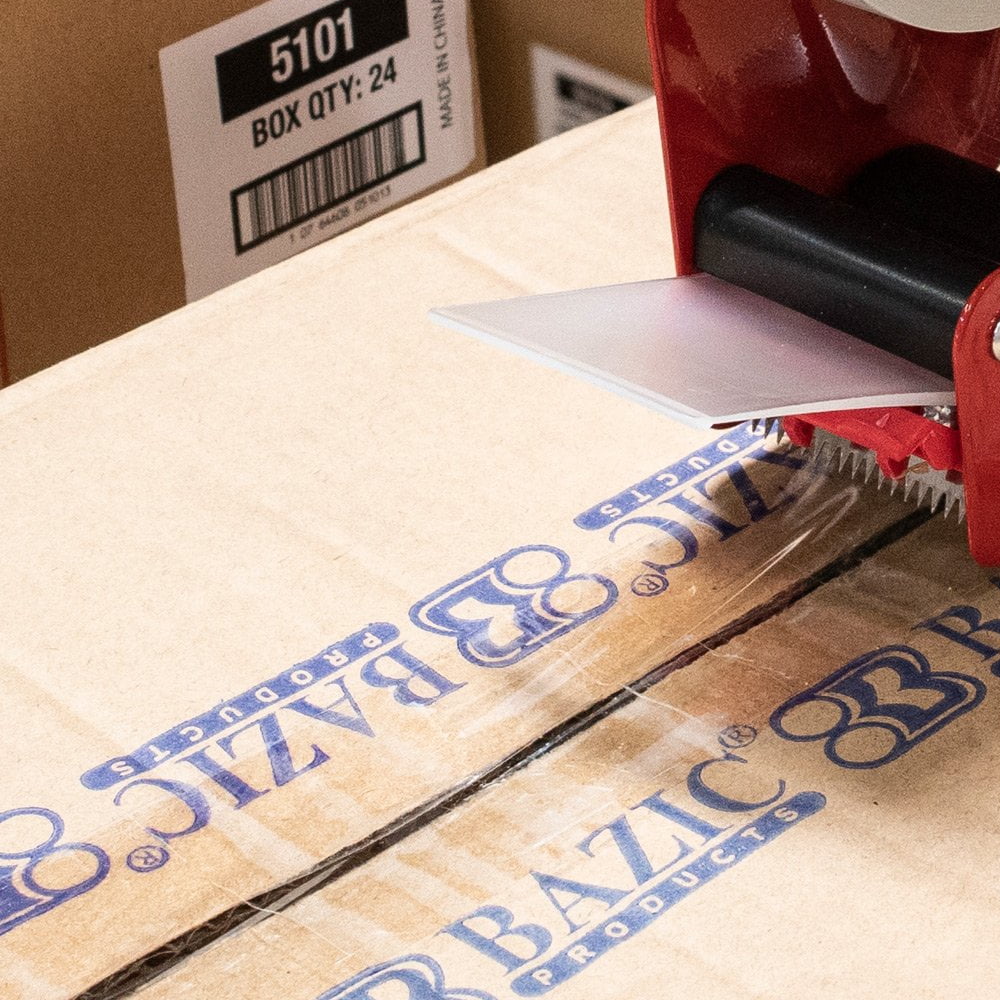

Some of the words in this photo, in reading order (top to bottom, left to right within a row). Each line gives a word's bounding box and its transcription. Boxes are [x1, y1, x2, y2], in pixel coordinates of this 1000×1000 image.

[270, 7, 354, 84] 5101
[435, 53, 449, 74] IN
[251, 103, 301, 148] BOX
[308, 74, 363, 121] QTY:
[369, 57, 398, 93] 24
[434, 76, 452, 129] MADE
[116, 631, 381, 777] PRODUCTS
[534, 806, 799, 987] PRODUCTS
